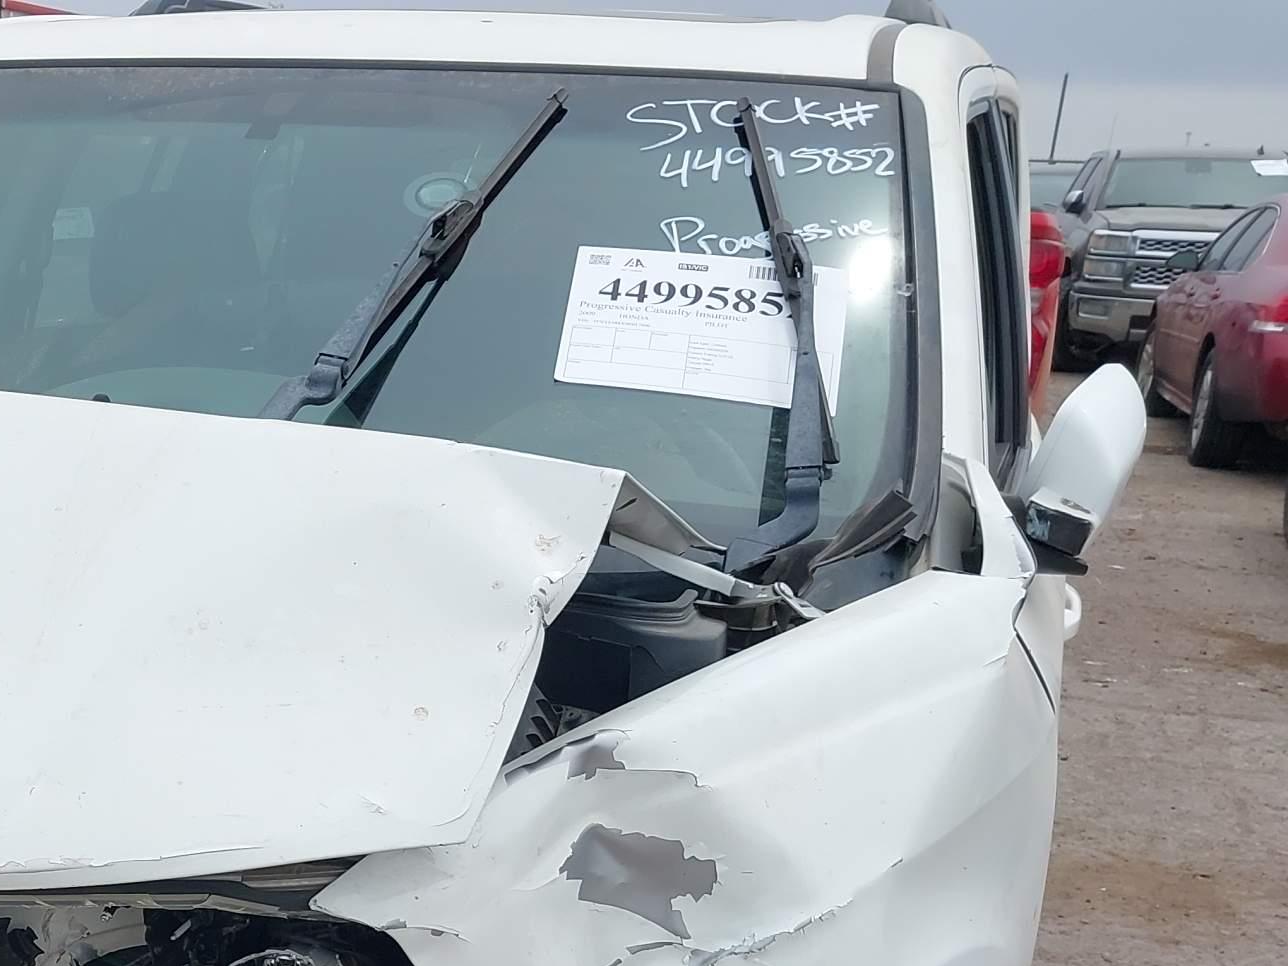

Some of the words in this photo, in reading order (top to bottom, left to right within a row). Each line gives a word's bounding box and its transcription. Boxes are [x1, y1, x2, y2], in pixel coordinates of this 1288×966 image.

[578, 300, 642, 313] Progressive
[644, 305, 692, 319] Casualty
[695, 310, 749, 323] Insurance
[598, 277, 793, 318] 4499585
